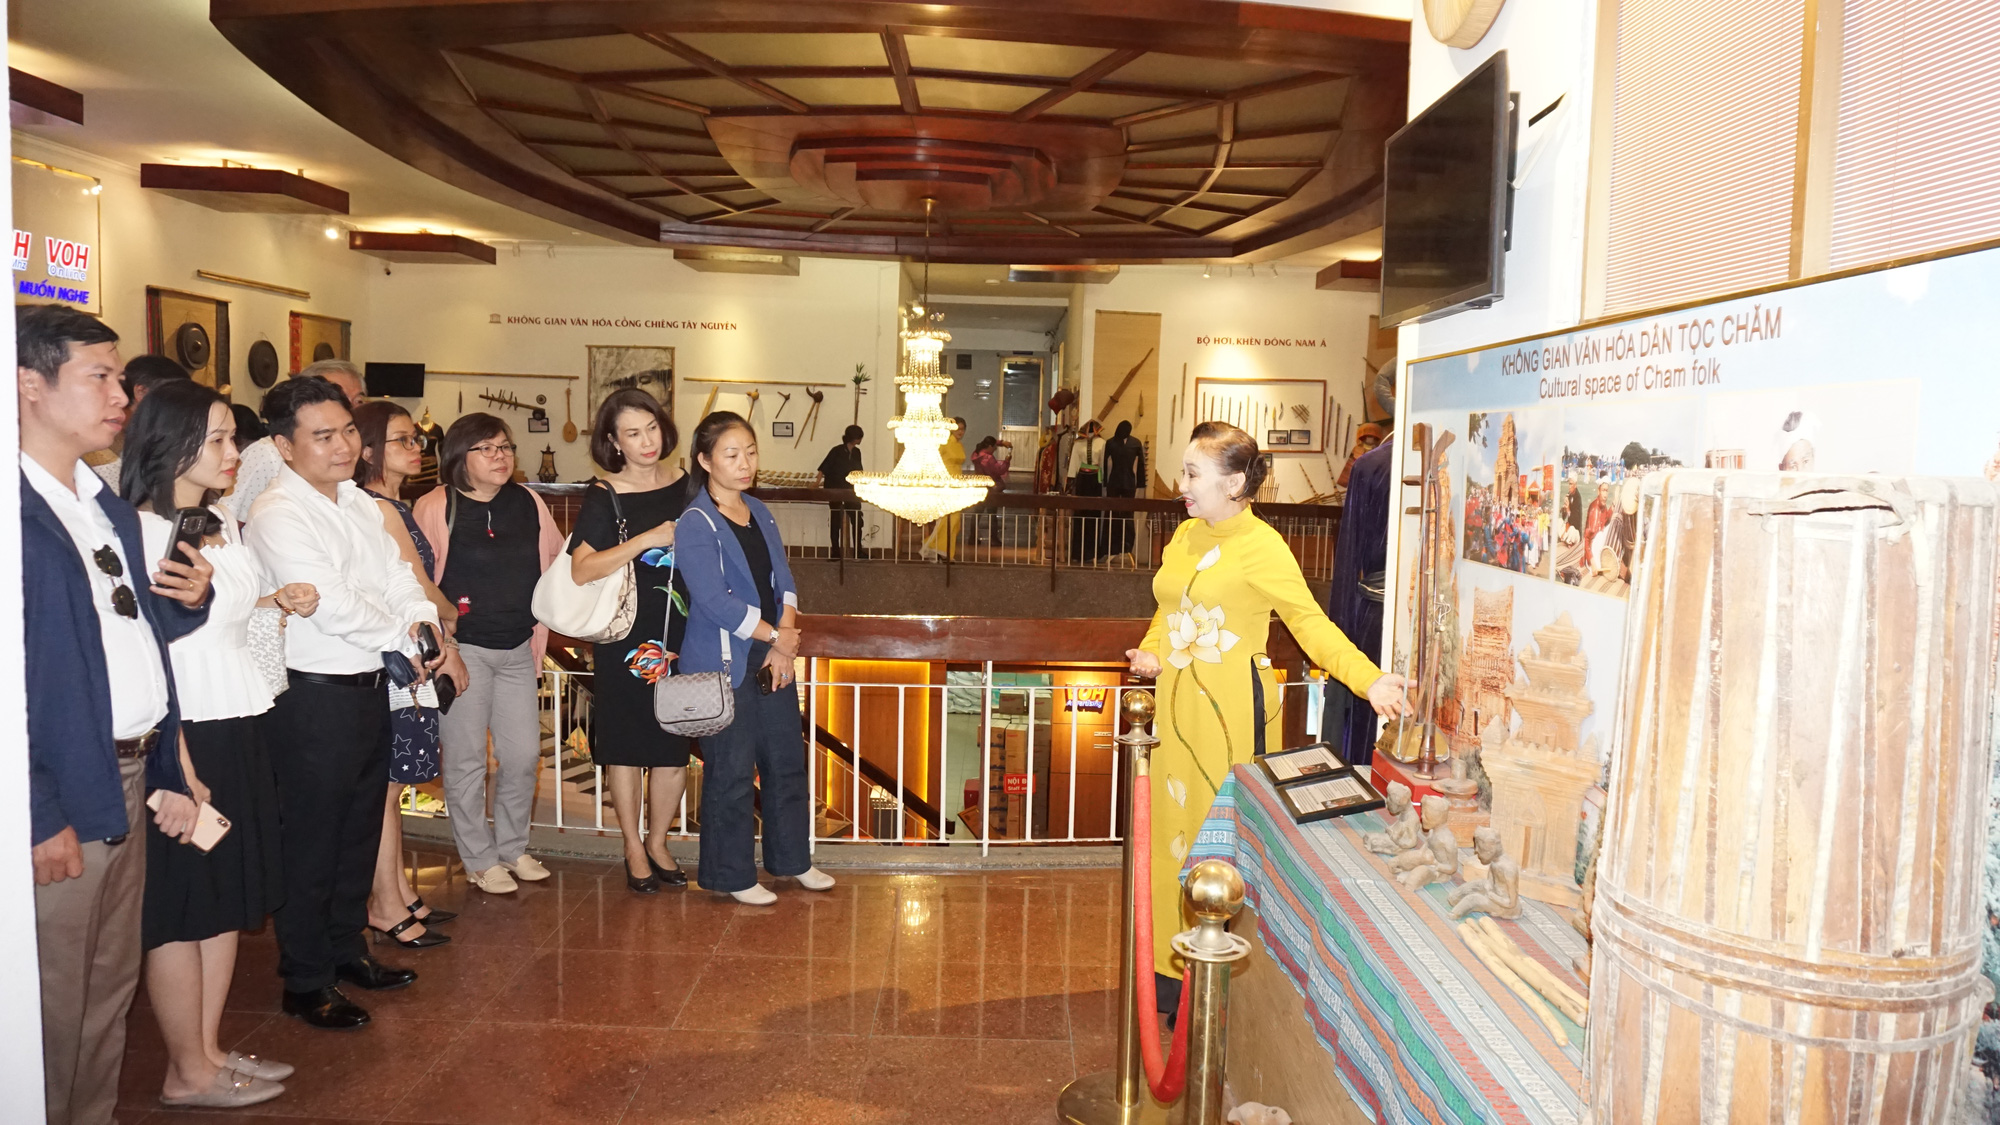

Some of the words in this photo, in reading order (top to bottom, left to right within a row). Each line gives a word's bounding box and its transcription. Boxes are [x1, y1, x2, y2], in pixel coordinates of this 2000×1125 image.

[47, 237, 90, 270] VOH
[49, 264, 87, 280] Online
[19, 279, 56, 298] MUỐN
[57, 287, 90, 304] NGHE
[507, 315, 541, 325] KHÔNG
[544, 317, 567, 326] GIAN
[592, 317, 613, 327] HÓA
[682, 320, 698, 330] TÂY
[1196, 335, 1211, 346] BỘ
[1264, 337, 1292, 347] ĐÔNG
[1295, 339, 1316, 347] NAM
[1502, 348, 1539, 376] KHÔNG
[1542, 344, 1571, 371] GIAN
[1574, 335, 1601, 366] VĂN
[1605, 329, 1636, 362] HÓA
[1640, 323, 1673, 357] DÂN
[1679, 318, 1715, 355] TỘC
[1721, 303, 1782, 346] CHĂM
[1539, 374, 1582, 399] Cultural
[1584, 375, 1622, 400] space
[1626, 366, 1640, 391] of
[1643, 365, 1686, 390] Cham
[1692, 357, 1722, 386] folk
